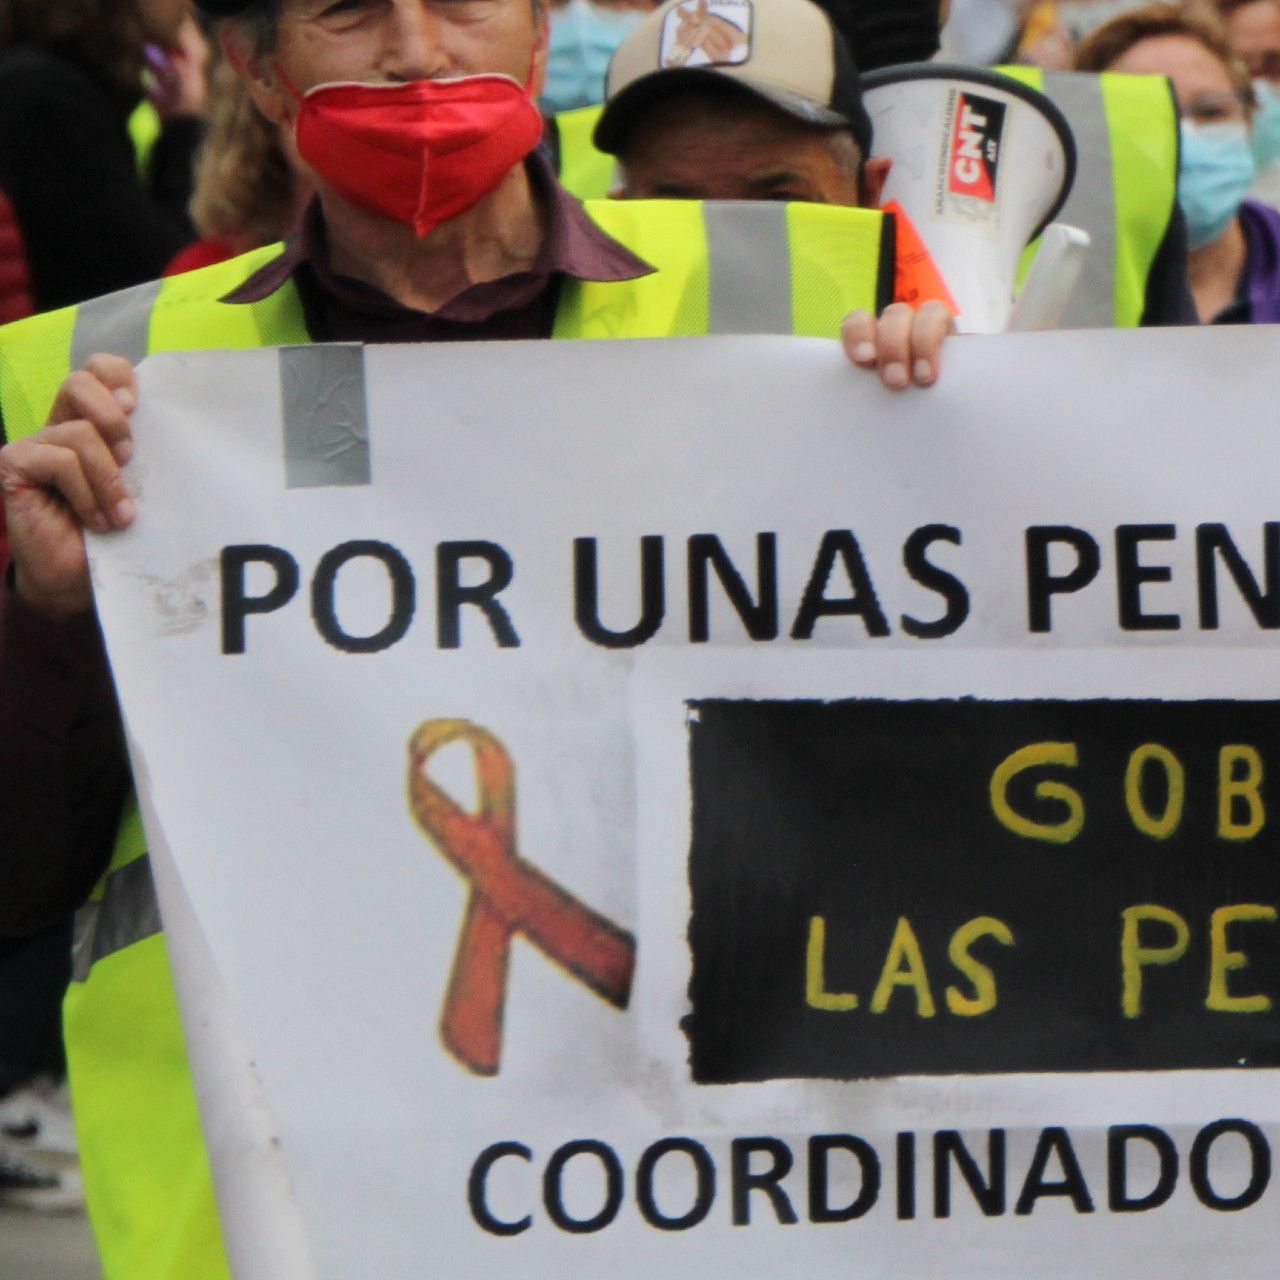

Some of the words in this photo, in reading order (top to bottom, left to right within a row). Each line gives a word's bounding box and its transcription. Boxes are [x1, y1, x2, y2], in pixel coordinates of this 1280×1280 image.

[954, 103, 989, 185] CNT
[219, 539, 521, 656] POR
[573, 522, 971, 650] UNAS
[804, 914, 1015, 1020] LAS
